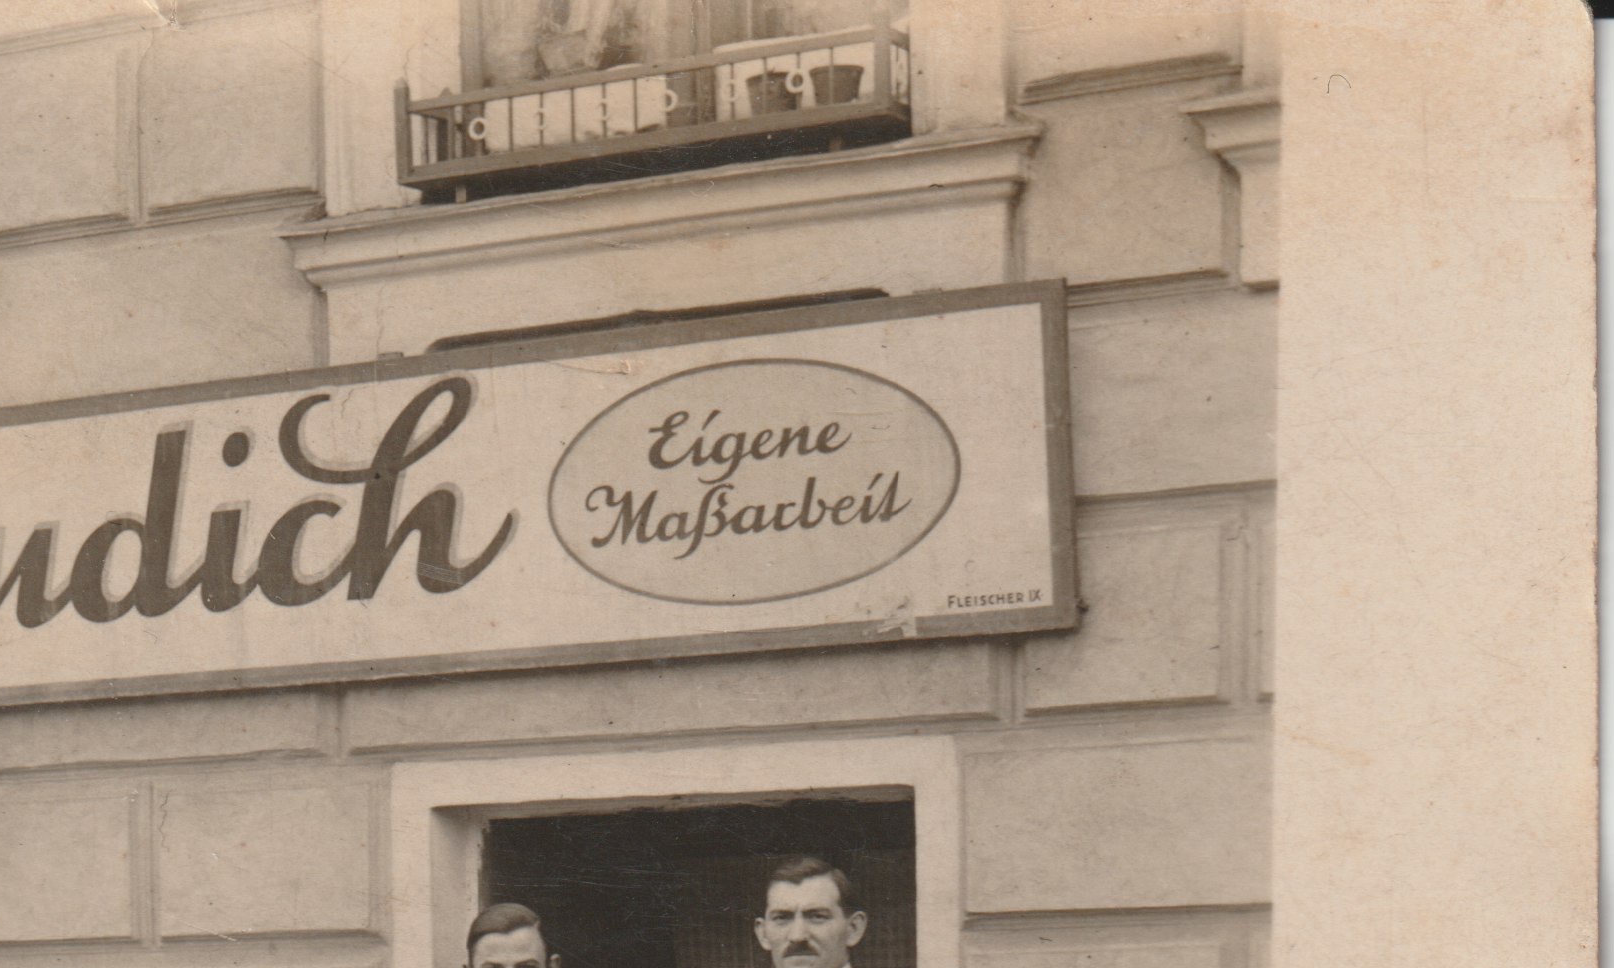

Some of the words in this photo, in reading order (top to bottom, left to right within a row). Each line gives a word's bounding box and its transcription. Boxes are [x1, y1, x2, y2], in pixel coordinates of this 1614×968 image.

[648, 409, 852, 484] Eigene
[585, 470, 911, 560] Maßarbeit
[947, 591, 1024, 608] FLEISCHER
